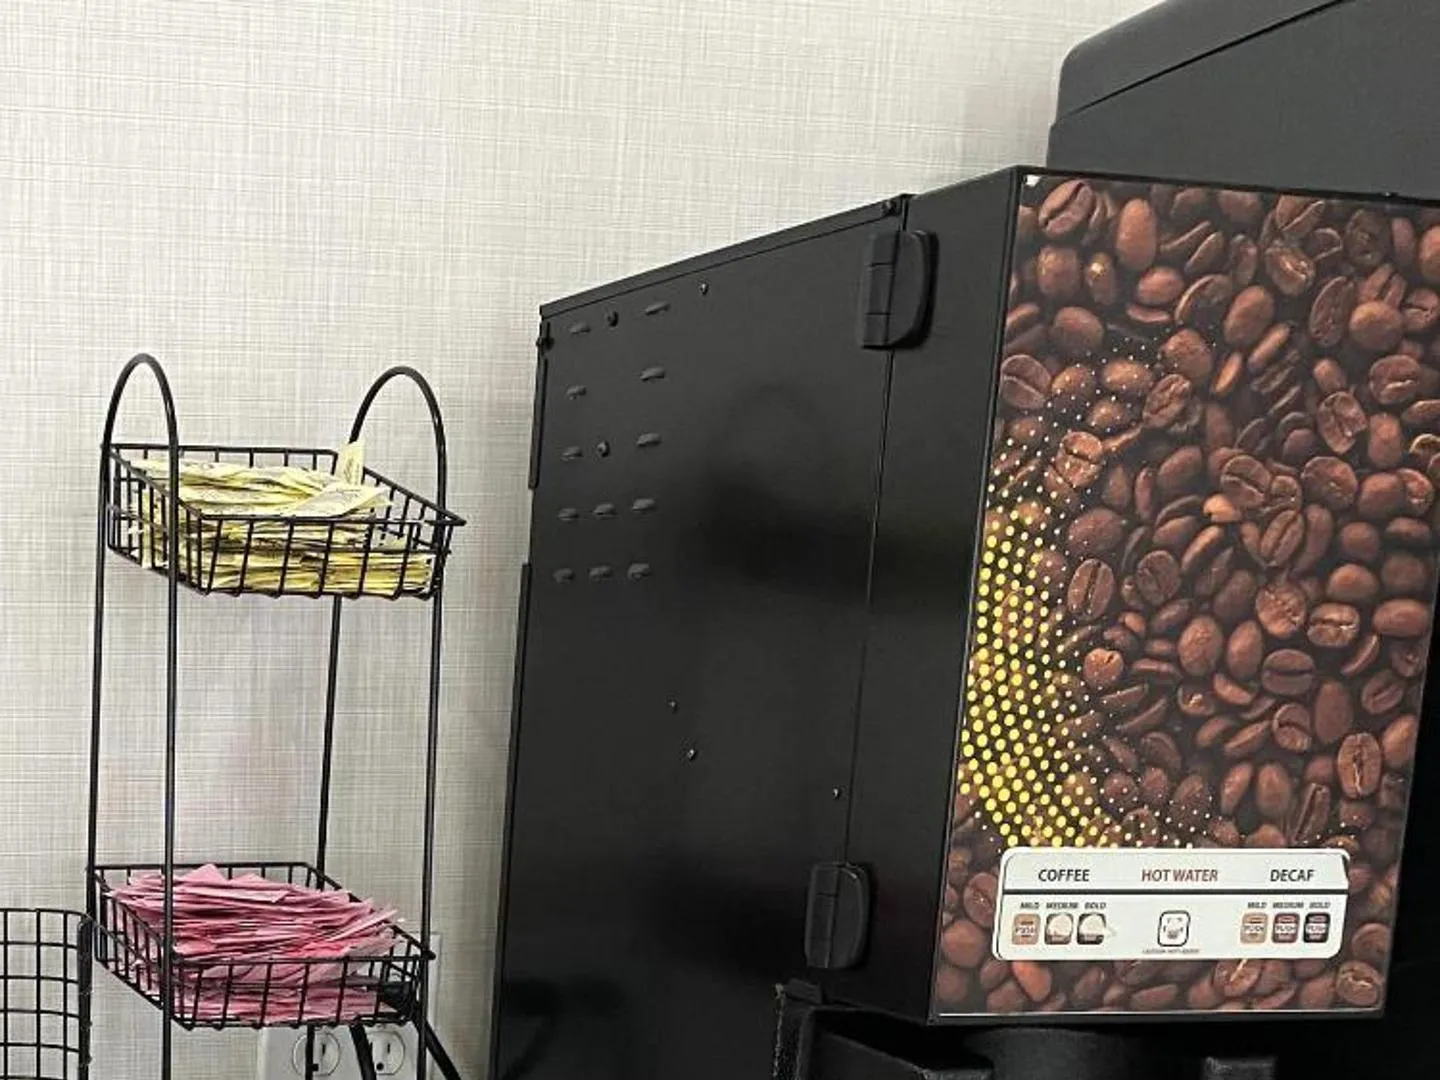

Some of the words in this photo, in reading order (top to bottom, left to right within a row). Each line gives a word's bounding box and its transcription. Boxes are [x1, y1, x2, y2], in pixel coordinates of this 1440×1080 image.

[1038, 869, 1091, 882] COFFEE
[1141, 869, 1171, 882] HOT
[1173, 869, 1219, 882] WATER
[1270, 869, 1315, 882] DECAF
